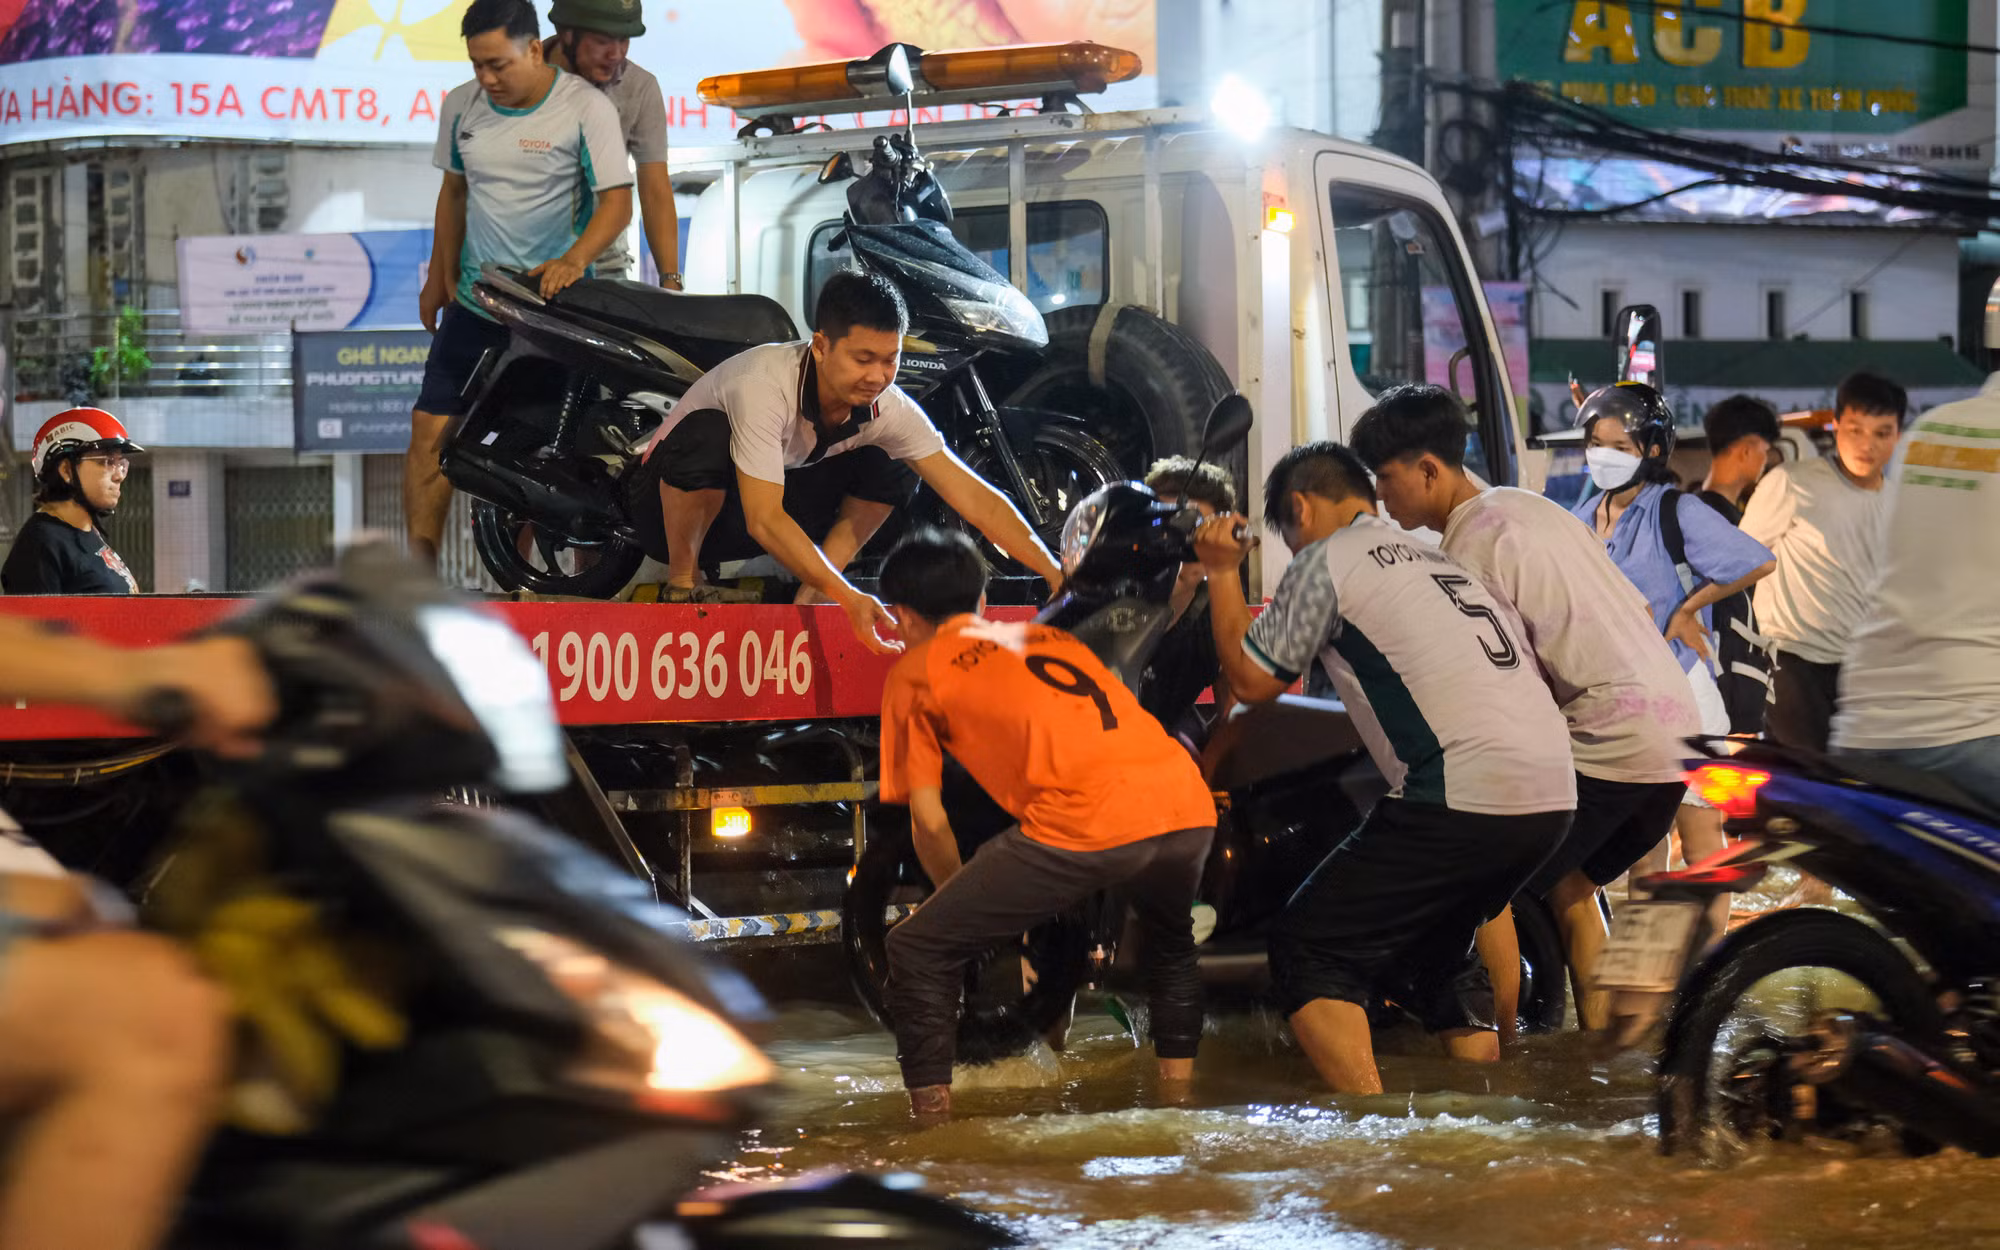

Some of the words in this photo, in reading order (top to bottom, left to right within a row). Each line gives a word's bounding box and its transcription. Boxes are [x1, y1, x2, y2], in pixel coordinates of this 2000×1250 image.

[1564, 0, 1812, 68] ACB
[31, 75, 153, 121] HÀNG:
[169, 82, 244, 118] 15A
[260, 86, 390, 127] CMT8,
[518, 138, 552, 150] TOYOTA
[1429, 573, 1521, 671] 5
[532, 630, 640, 702] 1900
[651, 631, 729, 700] 636
[738, 629, 813, 696] 046
[1025, 655, 1119, 732] 9
